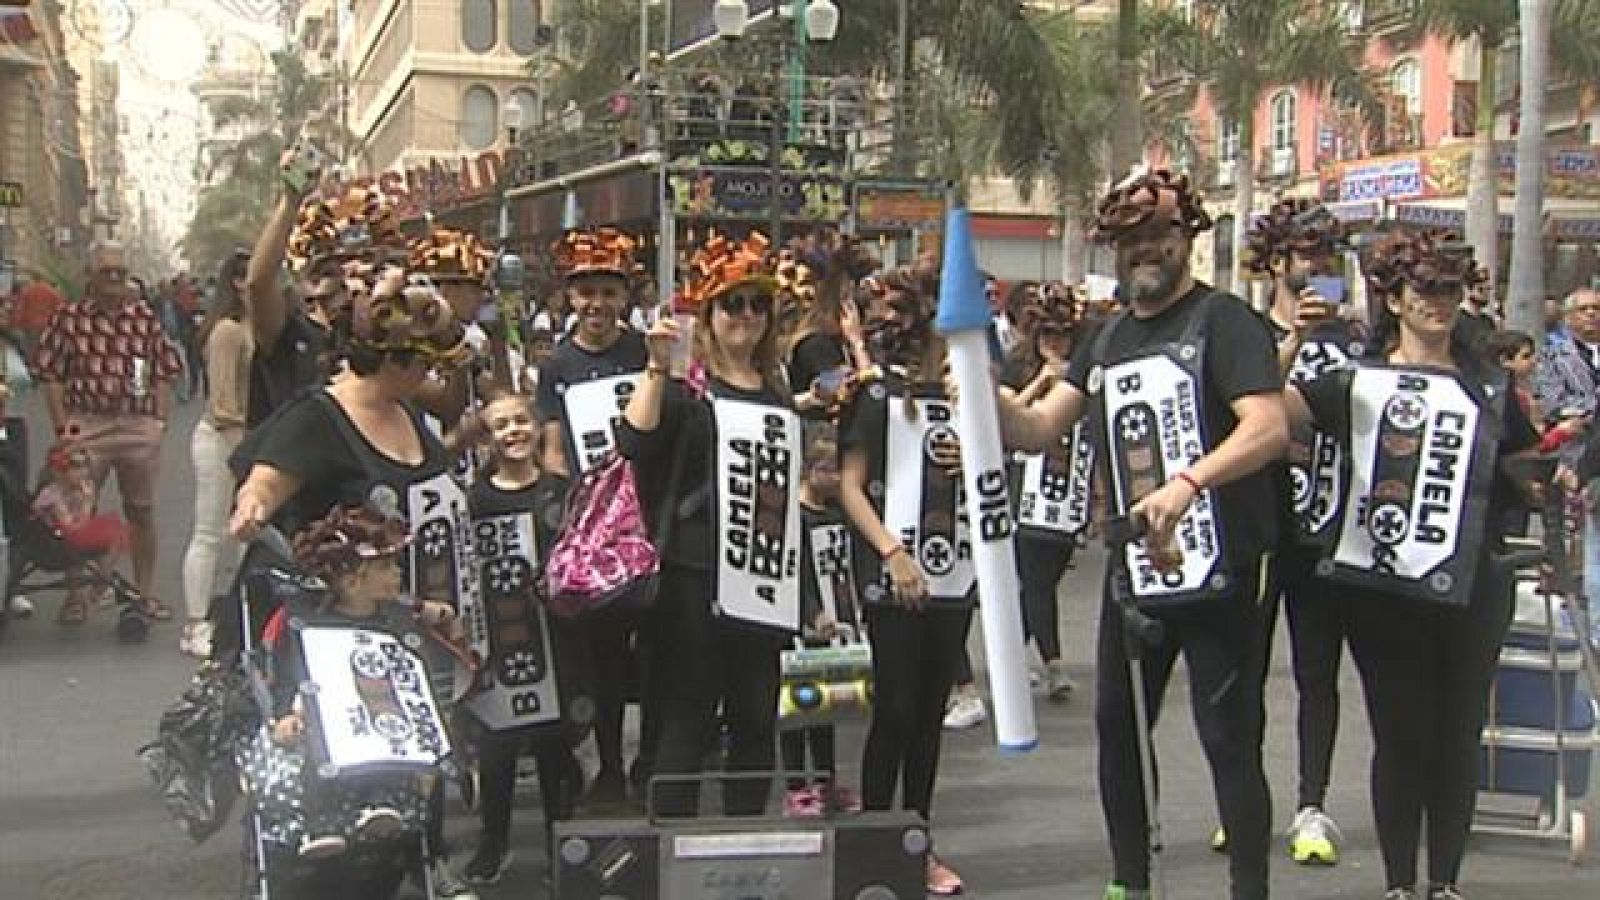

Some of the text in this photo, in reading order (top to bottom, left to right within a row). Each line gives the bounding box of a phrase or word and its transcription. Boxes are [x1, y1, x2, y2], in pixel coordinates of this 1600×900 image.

[723, 178, 794, 196] MOJIO
[1116, 372, 1141, 395] B
[1398, 374, 1429, 391] A
[926, 403, 951, 423] A
[1415, 410, 1466, 543] CAMELA
[420, 489, 441, 514] A
[725, 438, 753, 571] CAMELA
[976, 469, 1011, 543] BIG
[476, 520, 498, 556] 60
[755, 584, 776, 604] A
[379, 641, 422, 697] BABY
[511, 691, 541, 716] B
